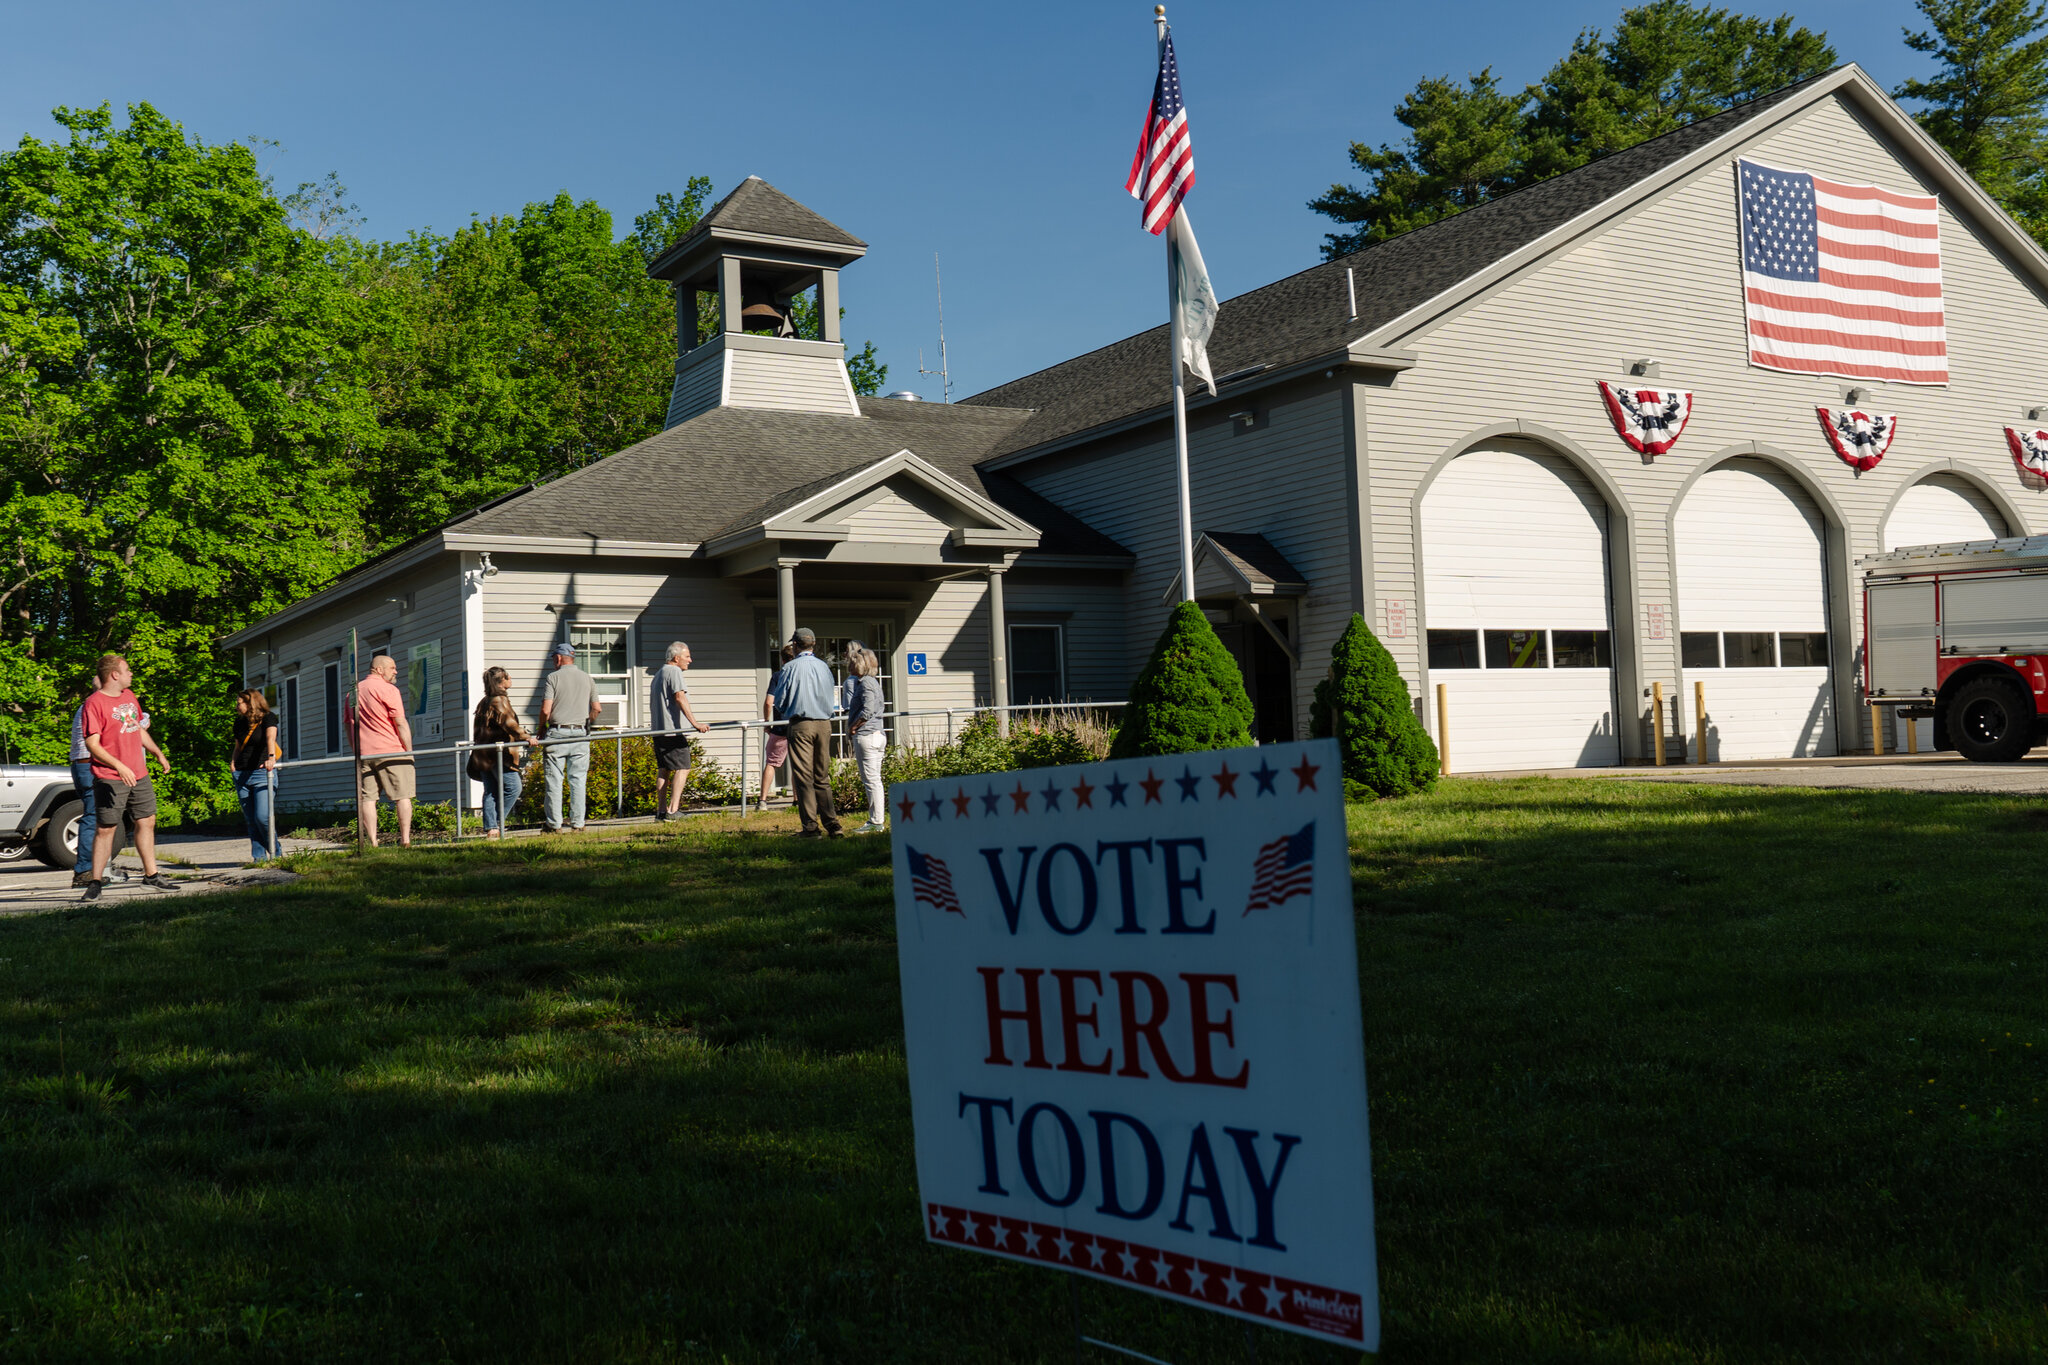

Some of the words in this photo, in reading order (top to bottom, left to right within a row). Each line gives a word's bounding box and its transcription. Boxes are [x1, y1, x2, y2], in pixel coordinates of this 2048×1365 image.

[979, 837, 1216, 936] VOTE
[977, 967, 1250, 1089] HERE
[958, 1091, 1302, 1253] TODAY
